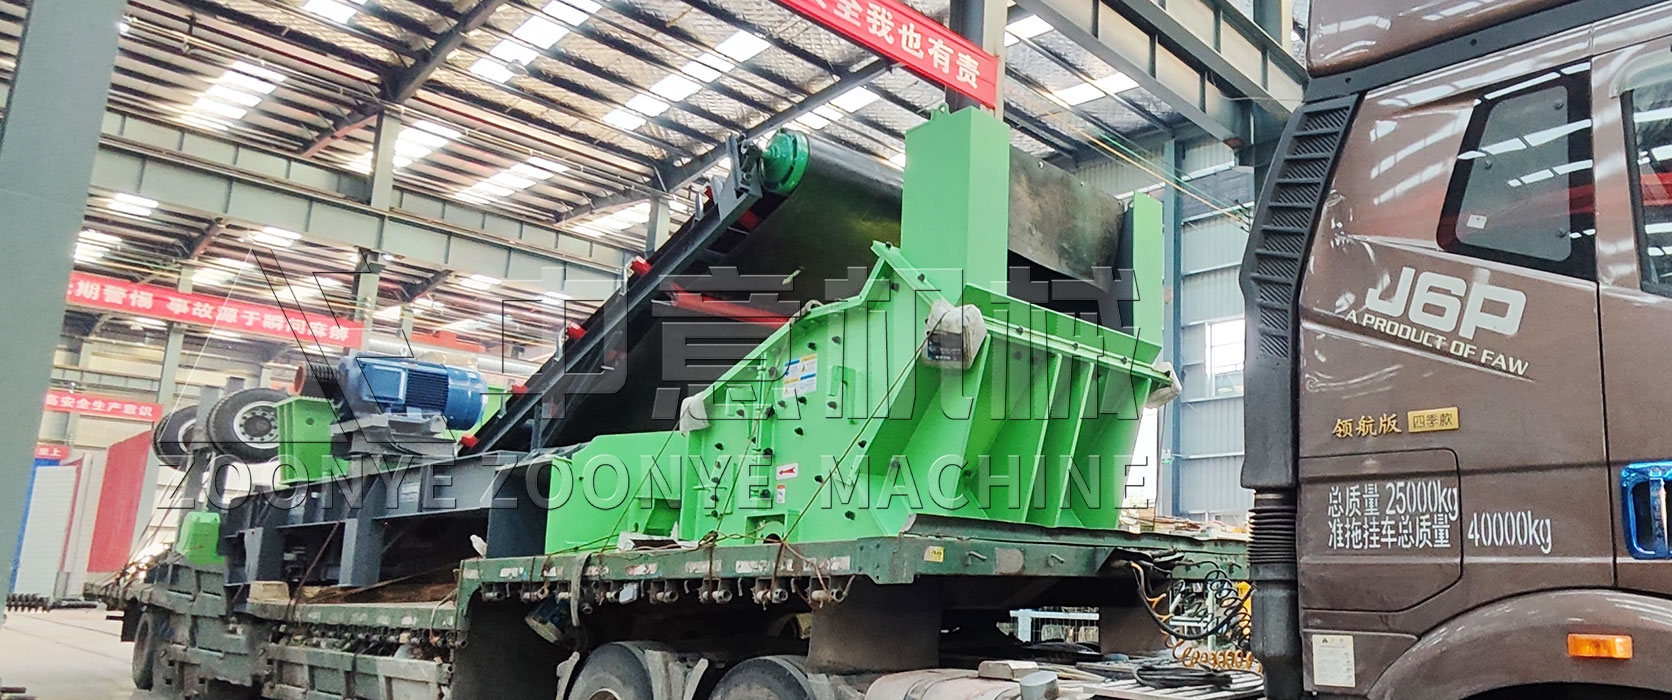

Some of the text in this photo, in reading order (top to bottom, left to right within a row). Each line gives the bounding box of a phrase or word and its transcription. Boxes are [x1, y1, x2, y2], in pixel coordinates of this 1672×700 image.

[815, 0, 981, 89] 全我也有责
[1365, 266, 1527, 340] J6P
[1345, 310, 1530, 377] A PRODUCT OF FAW
[1332, 413, 1402, 438] 领航版
[1413, 412, 1453, 429] 四季款
[1328, 480, 1459, 520] 总质量 25000kg
[1328, 511, 1552, 554] 准拖挂车总质量 40000kg
